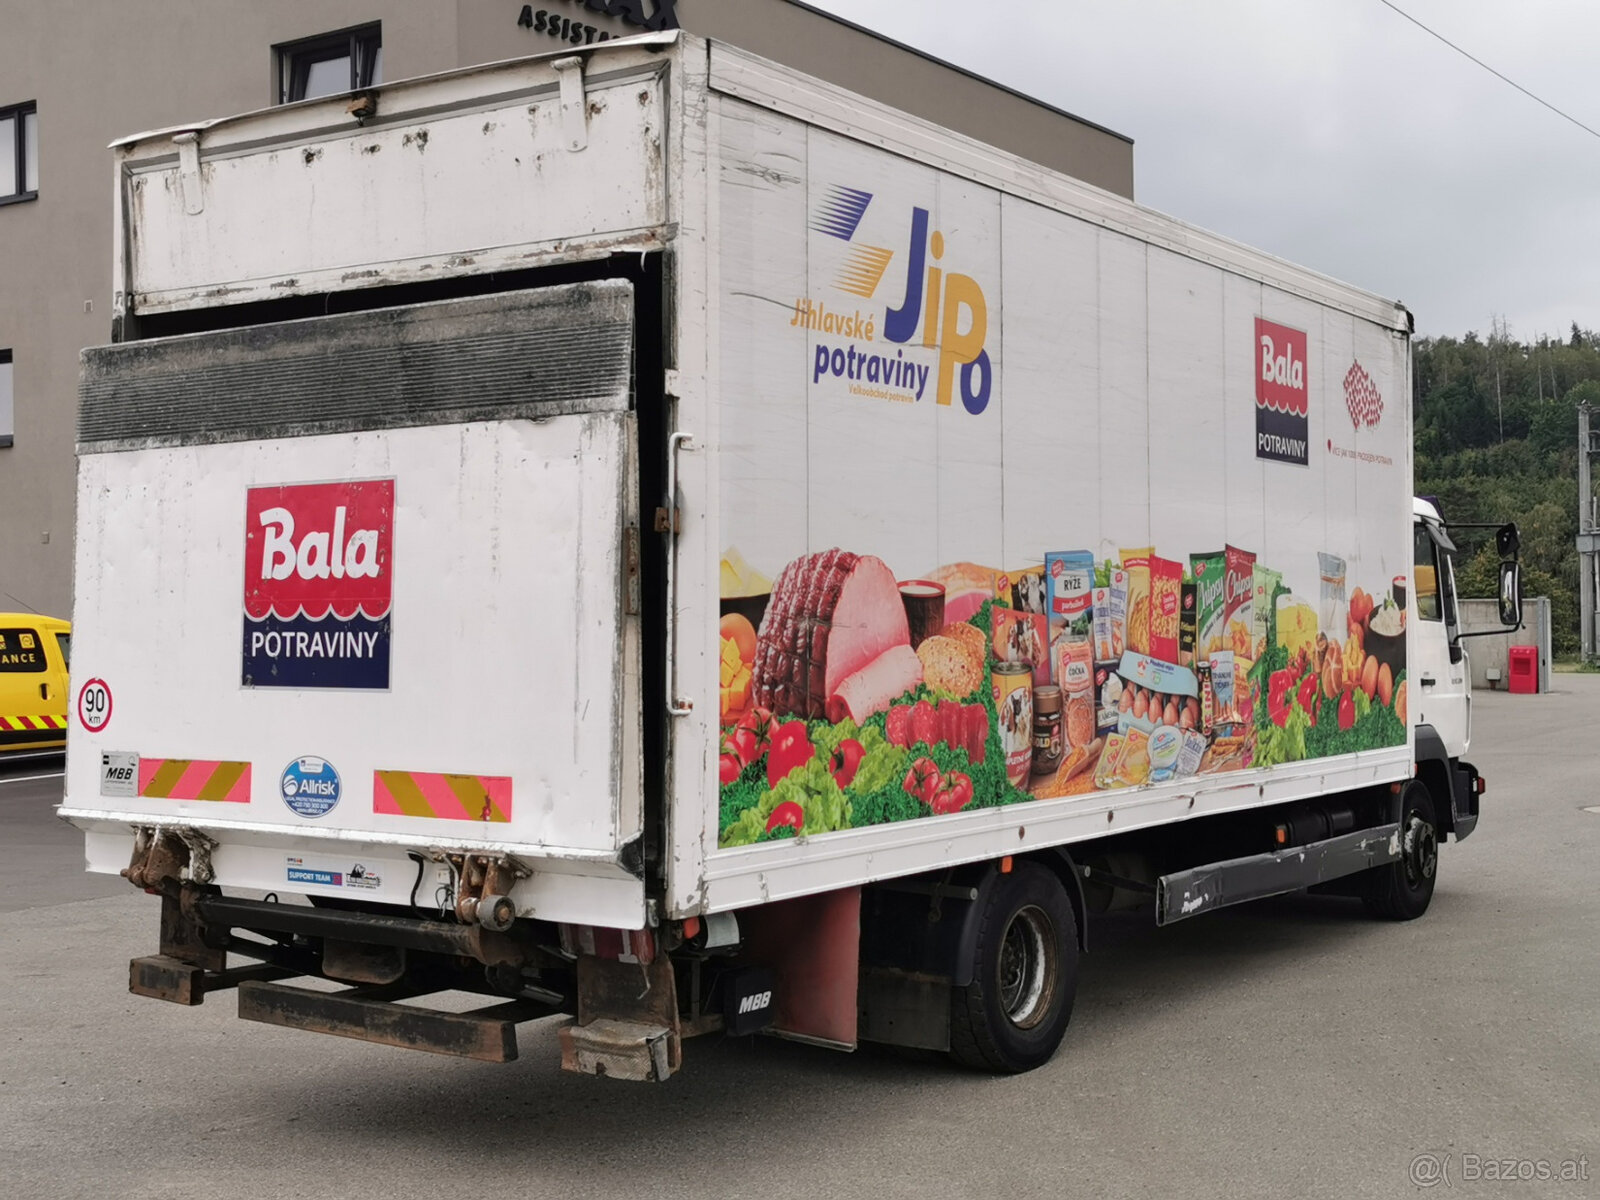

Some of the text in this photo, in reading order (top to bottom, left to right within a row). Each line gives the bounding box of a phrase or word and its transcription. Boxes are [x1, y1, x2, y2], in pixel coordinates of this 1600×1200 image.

[790, 298, 874, 342] Jihlavské
[813, 344, 930, 402] potraviny
[1260, 335, 1304, 390] Bala
[1258, 433, 1306, 458] POTRAVINY
[259, 506, 380, 581] Bala
[251, 631, 379, 658] POTRAVINY
[1, 653, 36, 664] ANCE
[85, 689, 105, 712] 90
[88, 713, 101, 724] km
[105, 767, 133, 780] MBB
[299, 779, 336, 795] Allrisk
[288, 870, 314, 881] SUPPORT
[315, 873, 331, 882] TEAM
[738, 990, 772, 1014] MBB
